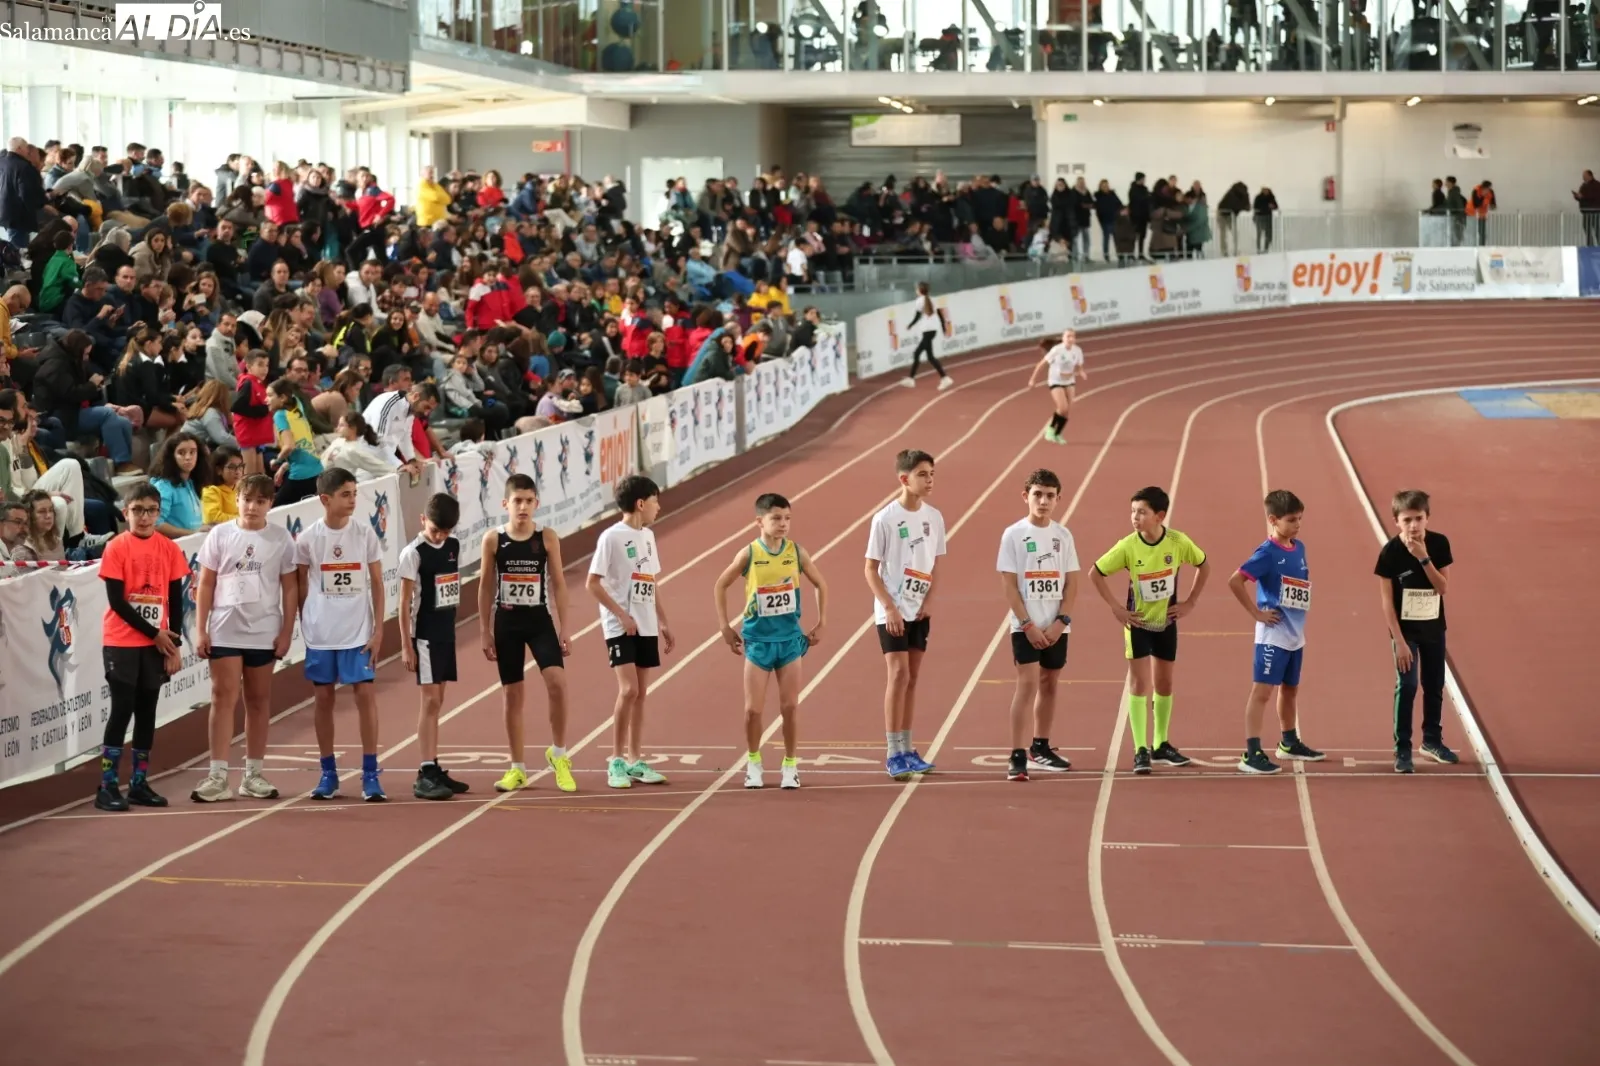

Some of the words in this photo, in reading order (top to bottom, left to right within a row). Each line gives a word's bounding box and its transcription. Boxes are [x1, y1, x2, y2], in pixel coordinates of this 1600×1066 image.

[1292, 251, 1383, 296] enjoy!
[1416, 265, 1477, 277] Ayuntamiento
[1430, 280, 1475, 292] Salamanca
[334, 572, 352, 586] 25
[1029, 580, 1059, 592] 1361
[1151, 579, 1167, 593] 52
[440, 583, 459, 598] 1388
[509, 584, 535, 597] 276
[1284, 586, 1309, 602] 1383
[766, 593, 790, 608] 229
[174, 674, 195, 694] CASTILLA
[67, 690, 92, 712] ATLETISMO
[31, 735, 39, 751] DE
[42, 724, 68, 747] CASTILLA
[78, 712, 92, 732] LEÓN
[4, 737, 20, 758] LEÓN
